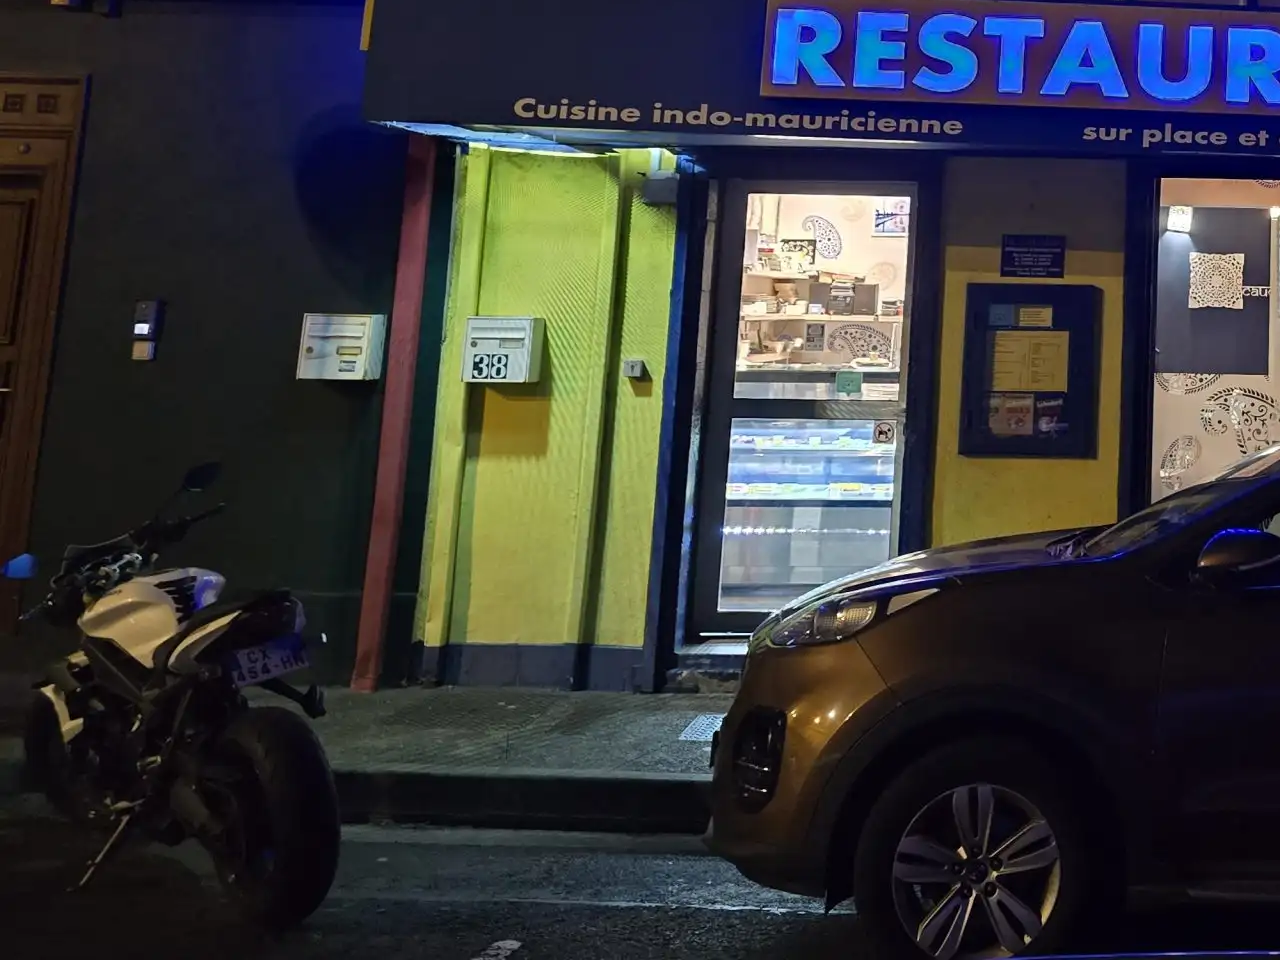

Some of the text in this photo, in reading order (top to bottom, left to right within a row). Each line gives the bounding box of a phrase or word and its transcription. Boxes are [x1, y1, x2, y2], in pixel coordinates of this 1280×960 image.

[513, 97, 964, 136] Cuisine indo-mauricienne
[1083, 124, 1133, 142] sur
[1143, 123, 1228, 148] place
[1238, 129, 1270, 147] et
[472, 354, 508, 380] 38
[246, 648, 272, 664] CX
